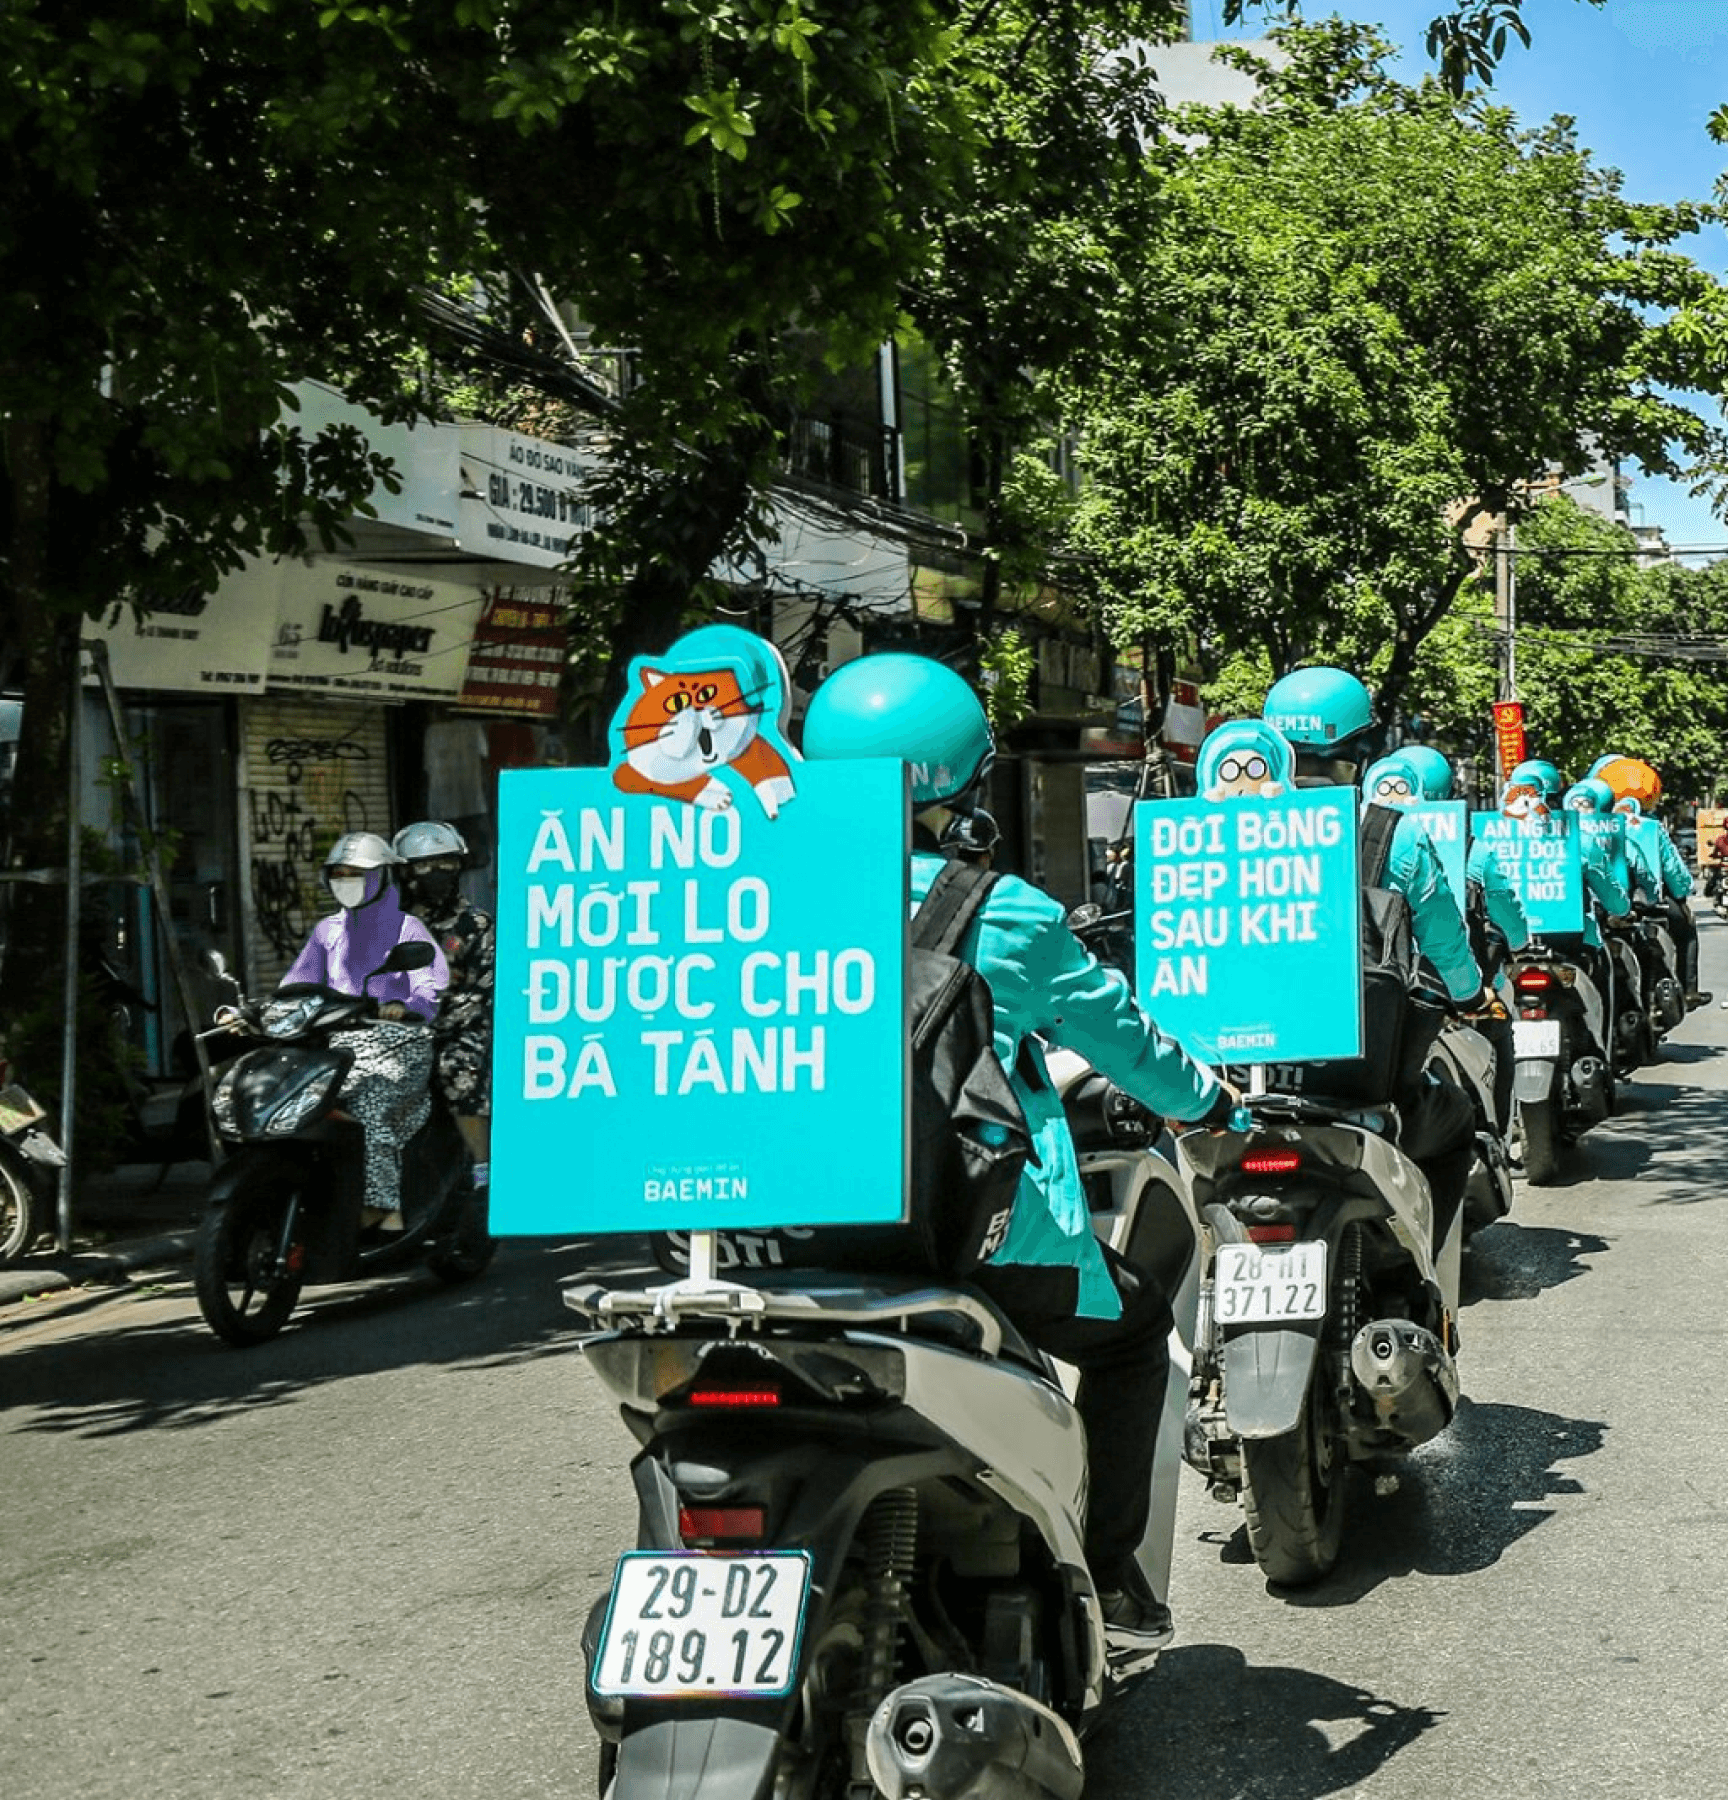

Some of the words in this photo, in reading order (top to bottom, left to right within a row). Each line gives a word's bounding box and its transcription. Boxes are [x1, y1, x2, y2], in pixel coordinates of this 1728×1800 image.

[526, 807, 625, 874] ĂN
[650, 804, 742, 869] NO
[1151, 861, 1228, 903] ĐẸP
[526, 881, 661, 950] MỚI
[684, 876, 771, 944] LO
[1150, 907, 1229, 950] SAU
[1240, 900, 1318, 945] KHI
[522, 954, 716, 1025] ĐƯỢC
[740, 947, 876, 1017] CHO
[1150, 954, 1208, 997] ĂN
[524, 1032, 617, 1100] BÁ
[640, 1025, 827, 1097] TÁNH
[1217, 1032, 1277, 1051] BAEMIN
[644, 1177, 748, 1202] BAEMIN
[1223, 1283, 1318, 1318] 371.22
[639, 1563, 779, 1620] 29-D2
[619, 1628, 784, 1685] 189.12
